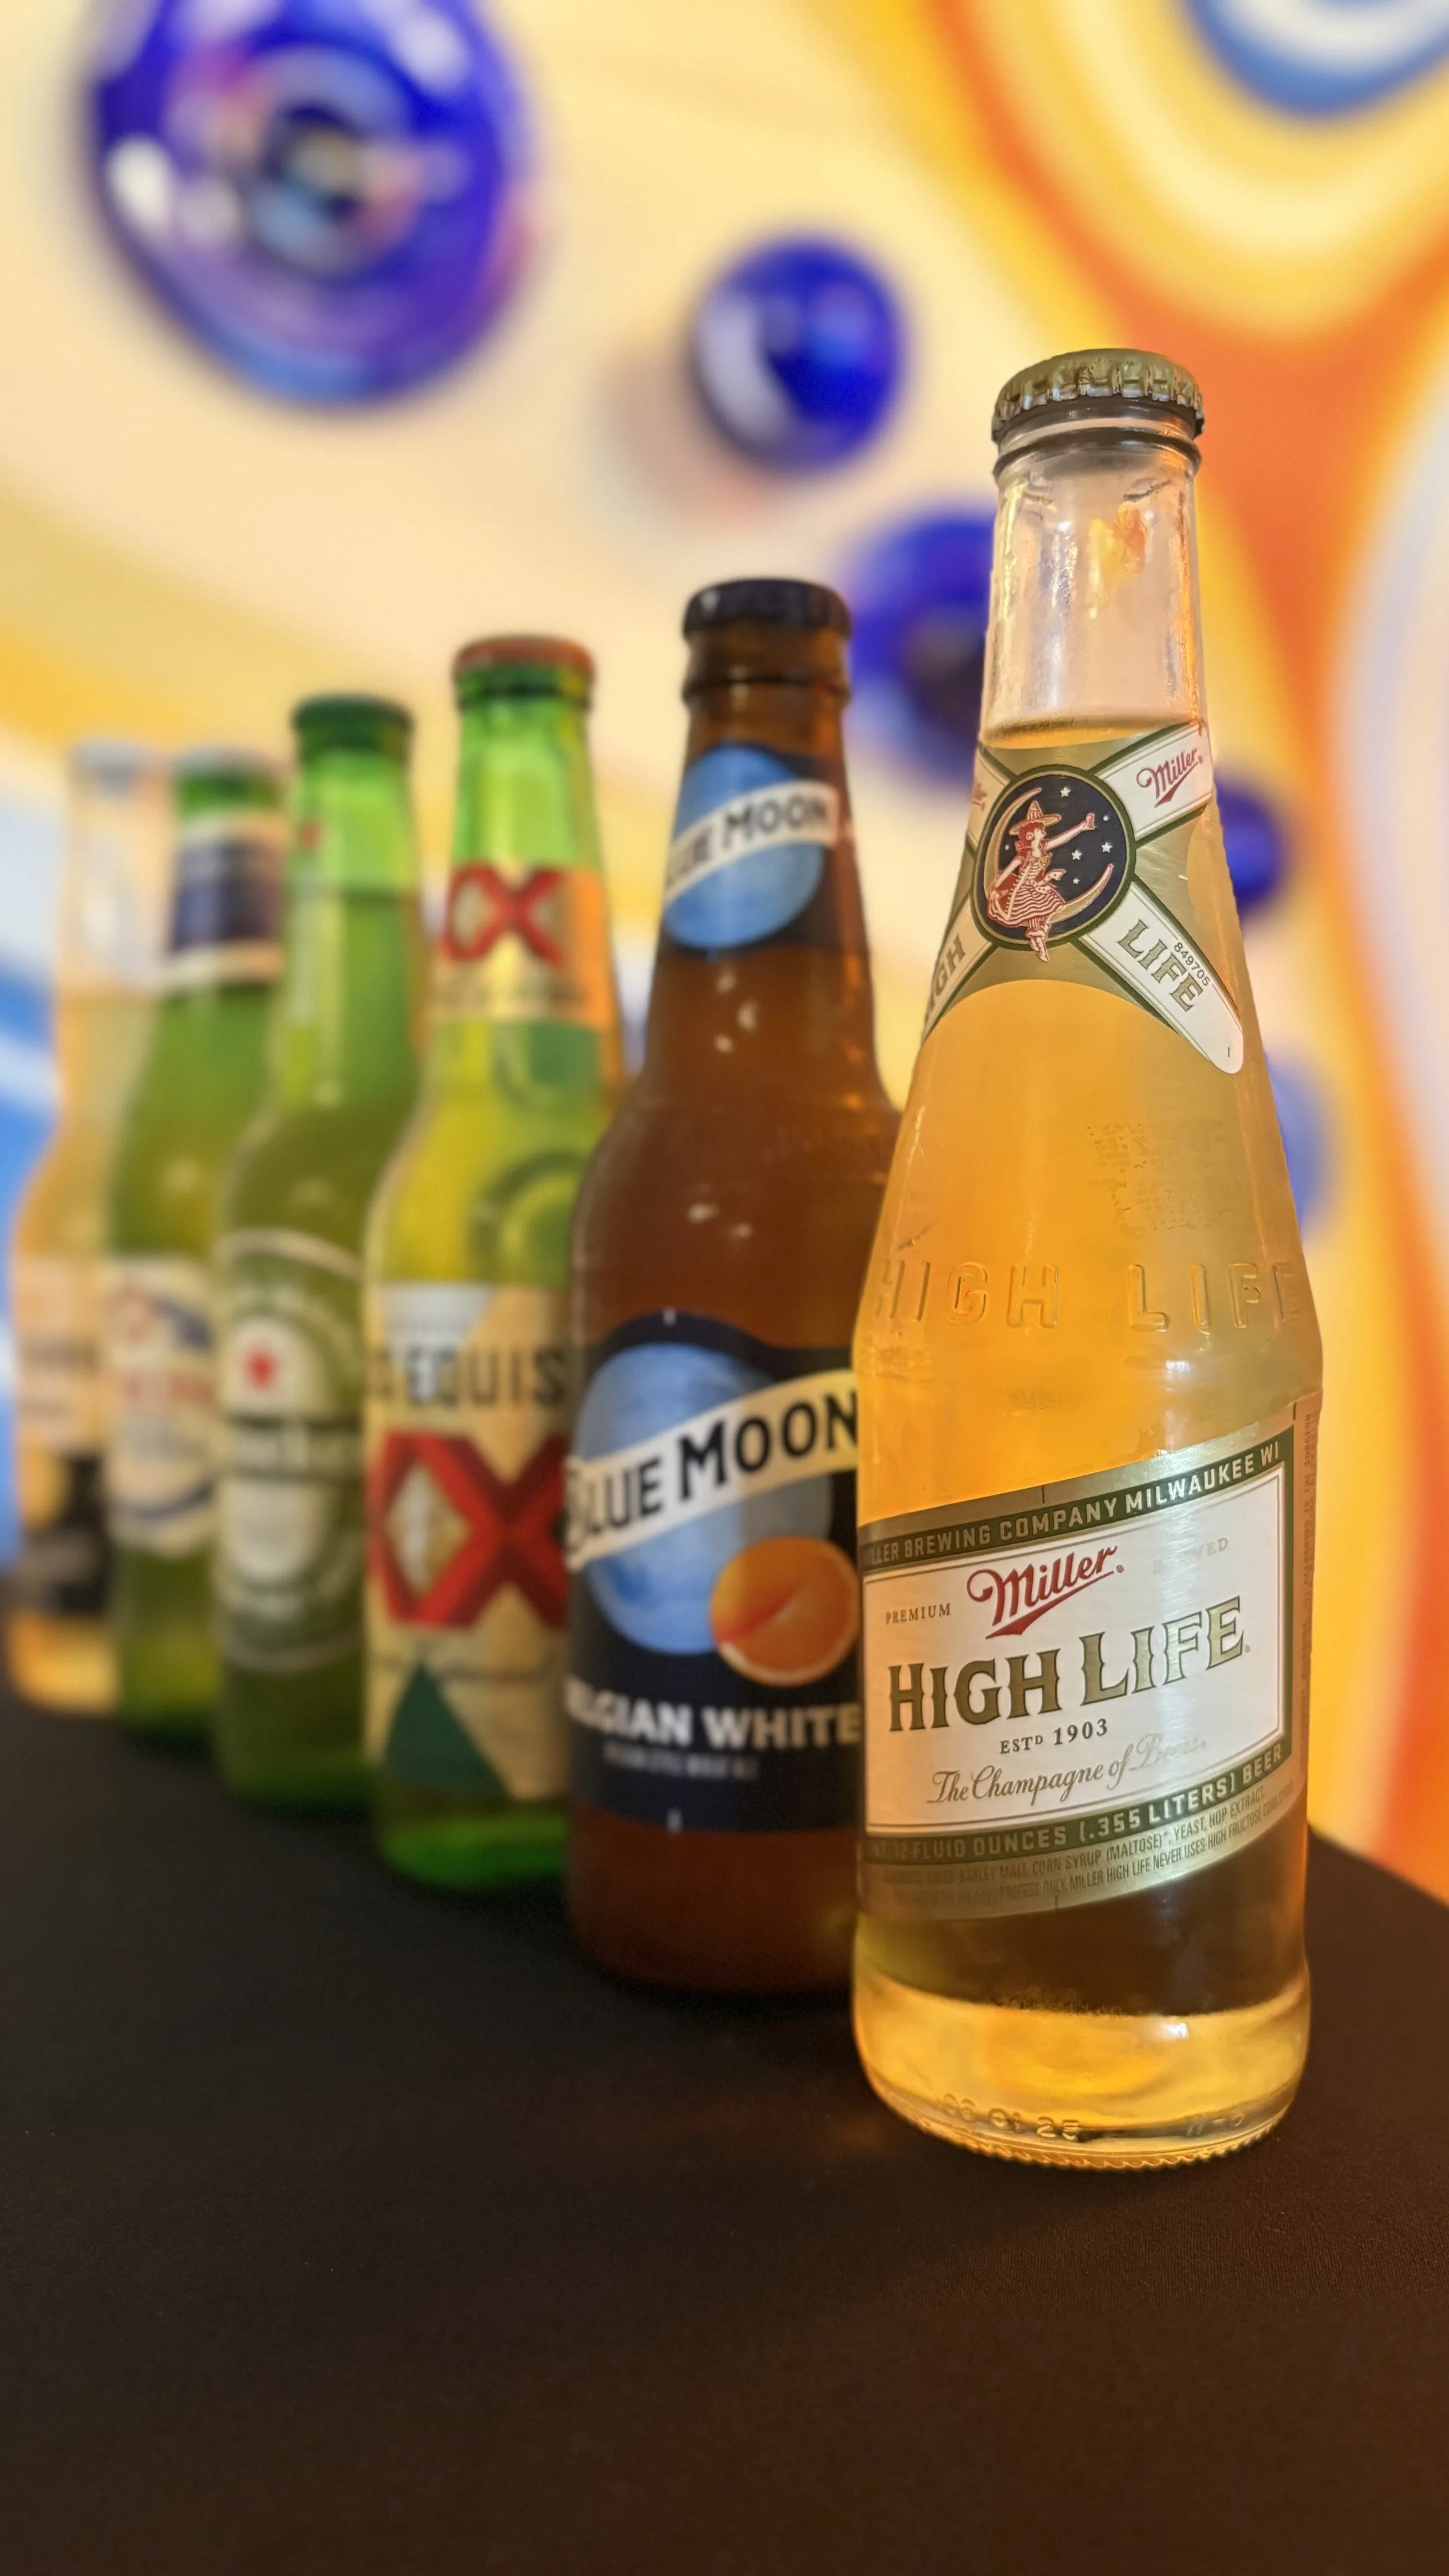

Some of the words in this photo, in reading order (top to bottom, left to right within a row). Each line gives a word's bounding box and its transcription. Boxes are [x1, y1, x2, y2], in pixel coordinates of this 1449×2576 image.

[1136, 747, 1199, 807] Miller
[1116, 918, 1204, 1013] LIFE
[1174, 941, 1211, 987] 849705
[876, 1258, 1059, 1330] HIGH
[679, 1390, 857, 1501] MOON
[904, 1525, 990, 1558] BREWING
[999, 1497, 1117, 1541] COMPANY
[1125, 1453, 1254, 1514] MILWAUKEE
[1260, 1441, 1279, 1467] WI
[885, 1602, 951, 1625] PREMIUM
[966, 1545, 1118, 1639] Miller
[888, 1648, 1061, 1732] HIGH
[1078, 1595, 1246, 1706] LIFE
[701, 1704, 861, 1748] WHITE
[1053, 1718, 1108, 1746] 1903
[912, 1839, 966, 1860] FLUID
[973, 1825, 1067, 1856] OUNCES
[1079, 1808, 1141, 1843] (.355
[1148, 1773, 1235, 1824] LITERS)
[1242, 1743, 1281, 1785] BEER
[927, 1769, 969, 1803] The
[970, 1765, 1102, 1805] Champagne
[1106, 1742, 1134, 1790] of
[1032, 1857, 1061, 1875] CORN
[1065, 1850, 1101, 1871] SYRUP
[1209, 1808, 1228, 1827] HOP
[1070, 1867, 1103, 1890] MILLER
[1106, 1862, 1130, 1882] HIGH
[1132, 1858, 1151, 1876] LIFE
[1153, 1849, 1182, 1871] NEVER
[1184, 1838, 1206, 1858] USES
[1207, 1828, 1227, 1850] HIGH
[1228, 1813, 1263, 1842] FRUCTOSE
